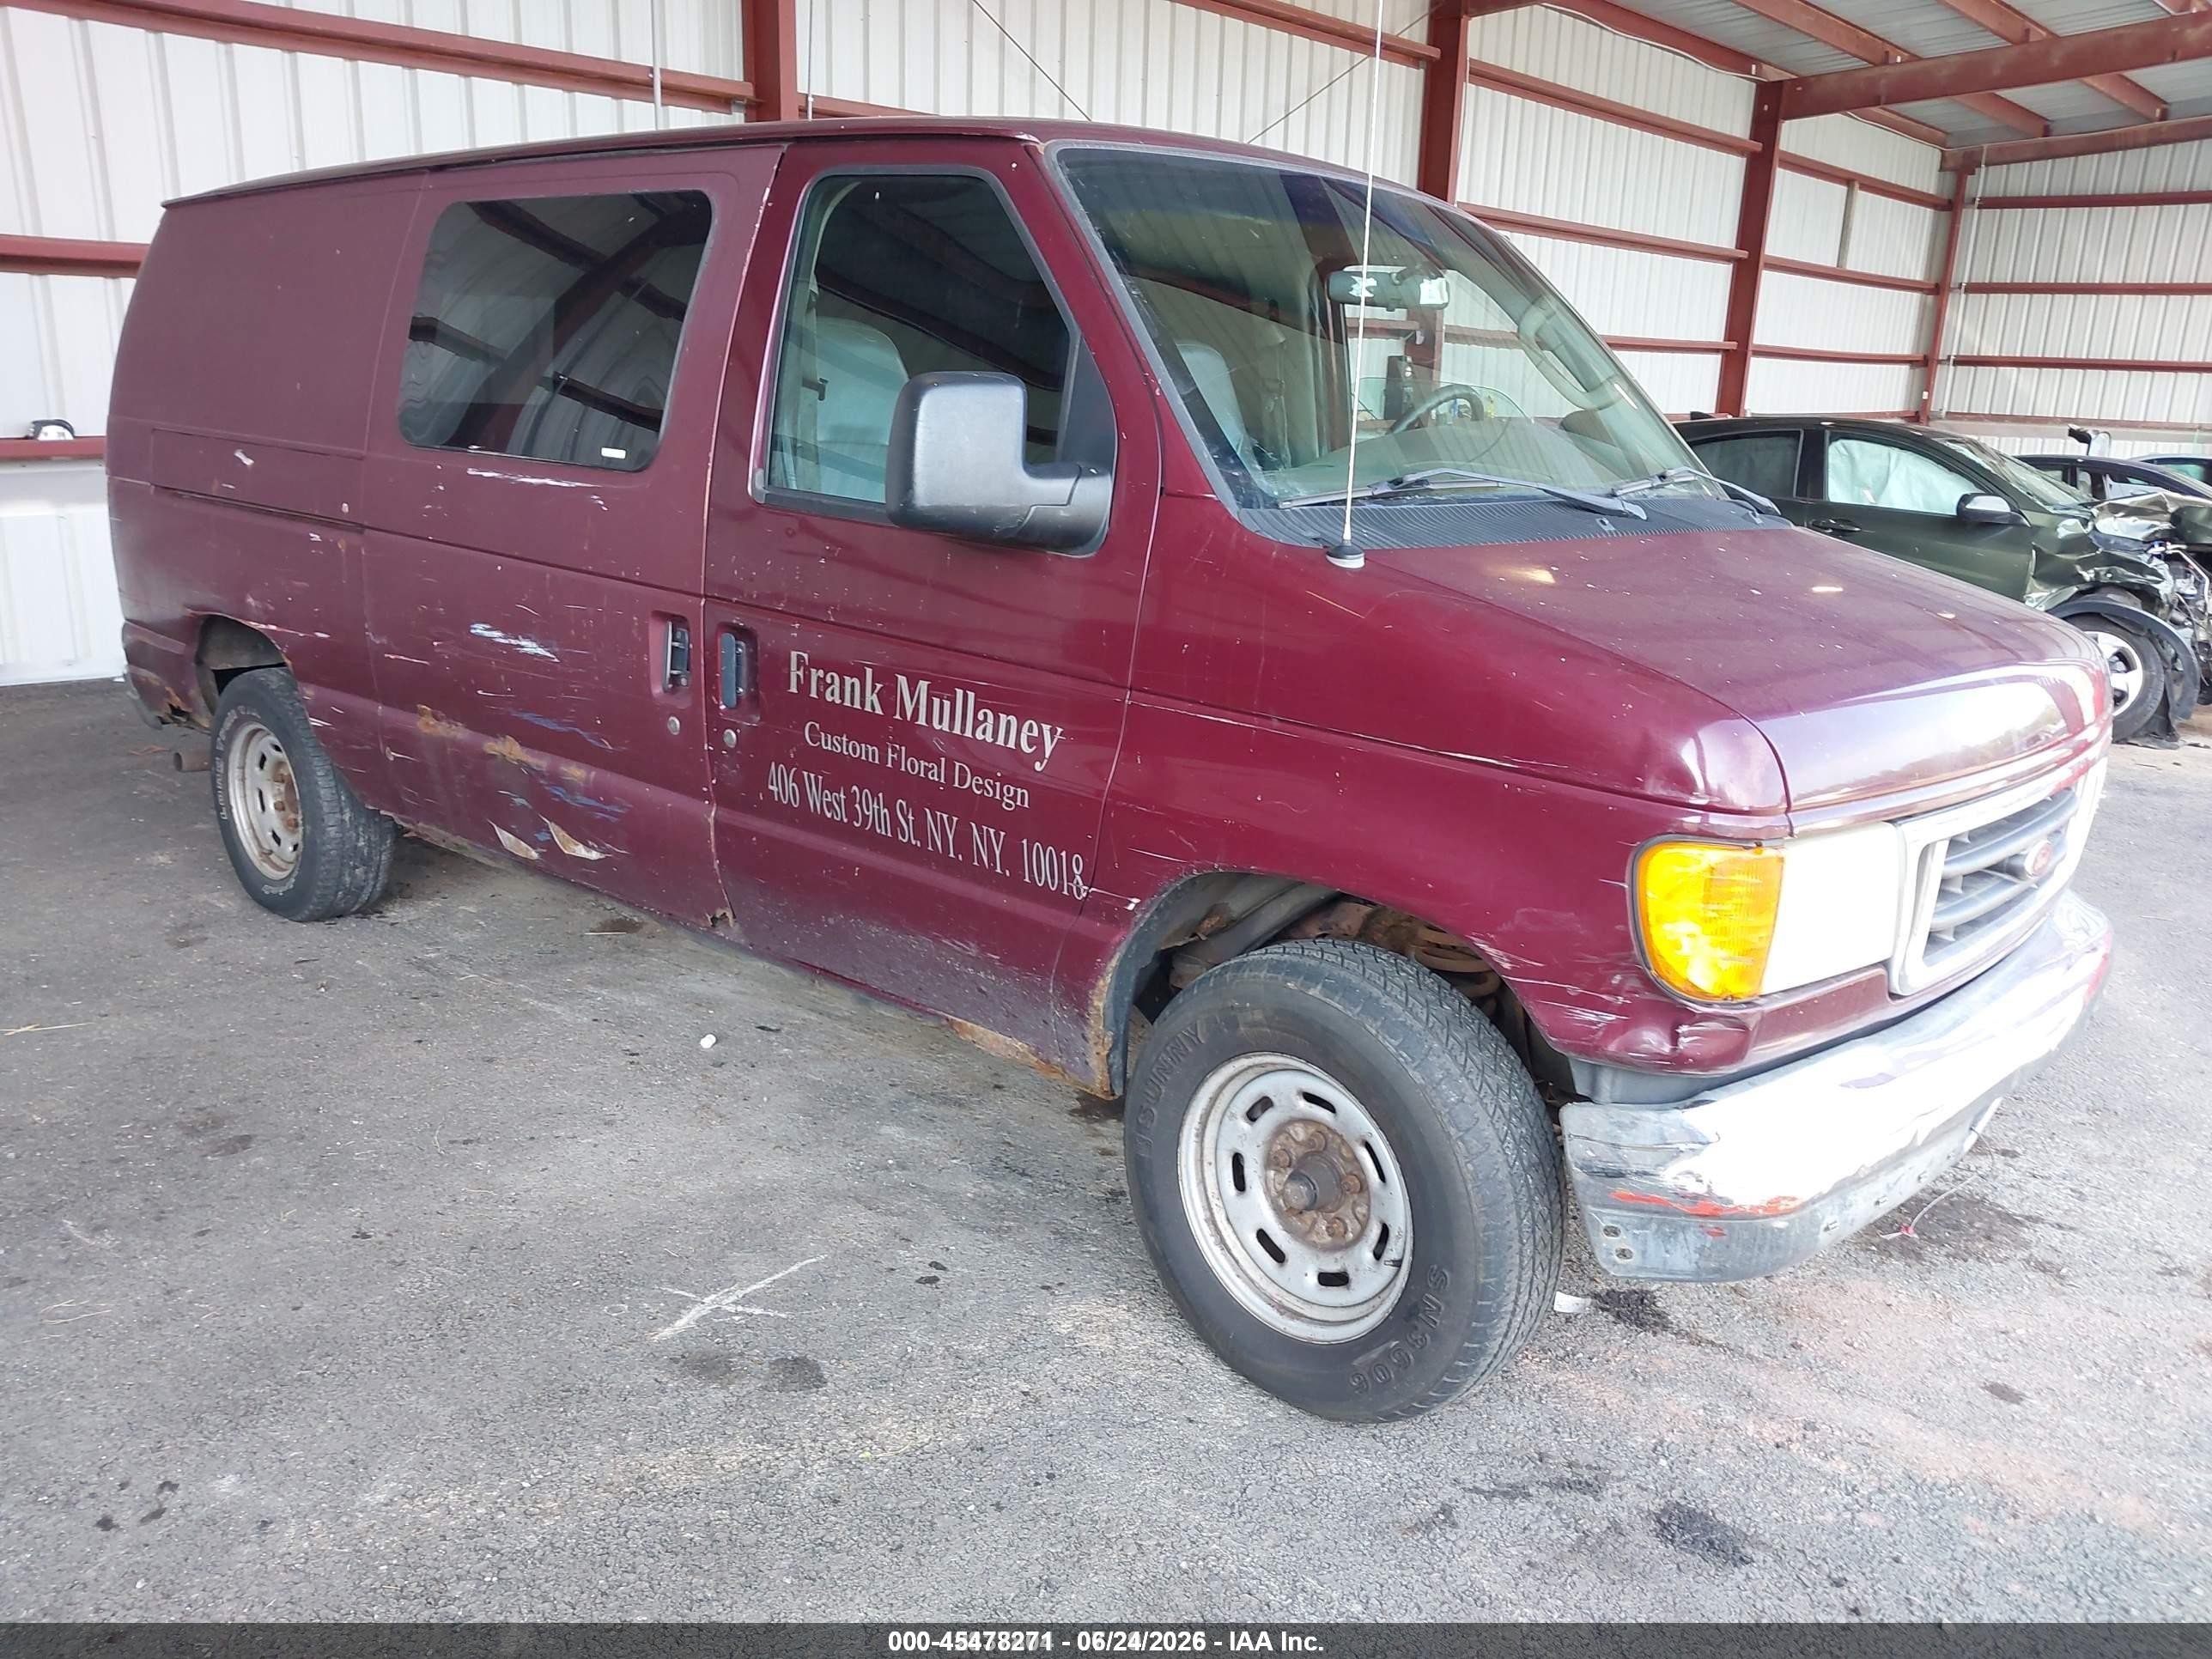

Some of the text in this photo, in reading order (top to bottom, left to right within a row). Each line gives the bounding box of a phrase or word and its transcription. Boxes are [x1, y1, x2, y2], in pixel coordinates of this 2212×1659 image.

[787, 650, 1065, 772] Frank Mullaney
[804, 721, 1030, 811] Custom Floral Design
[768, 762, 1087, 901] 406 West 39th St. NY. NY. 10018
[1137, 1020, 1206, 1128] SUNNY
